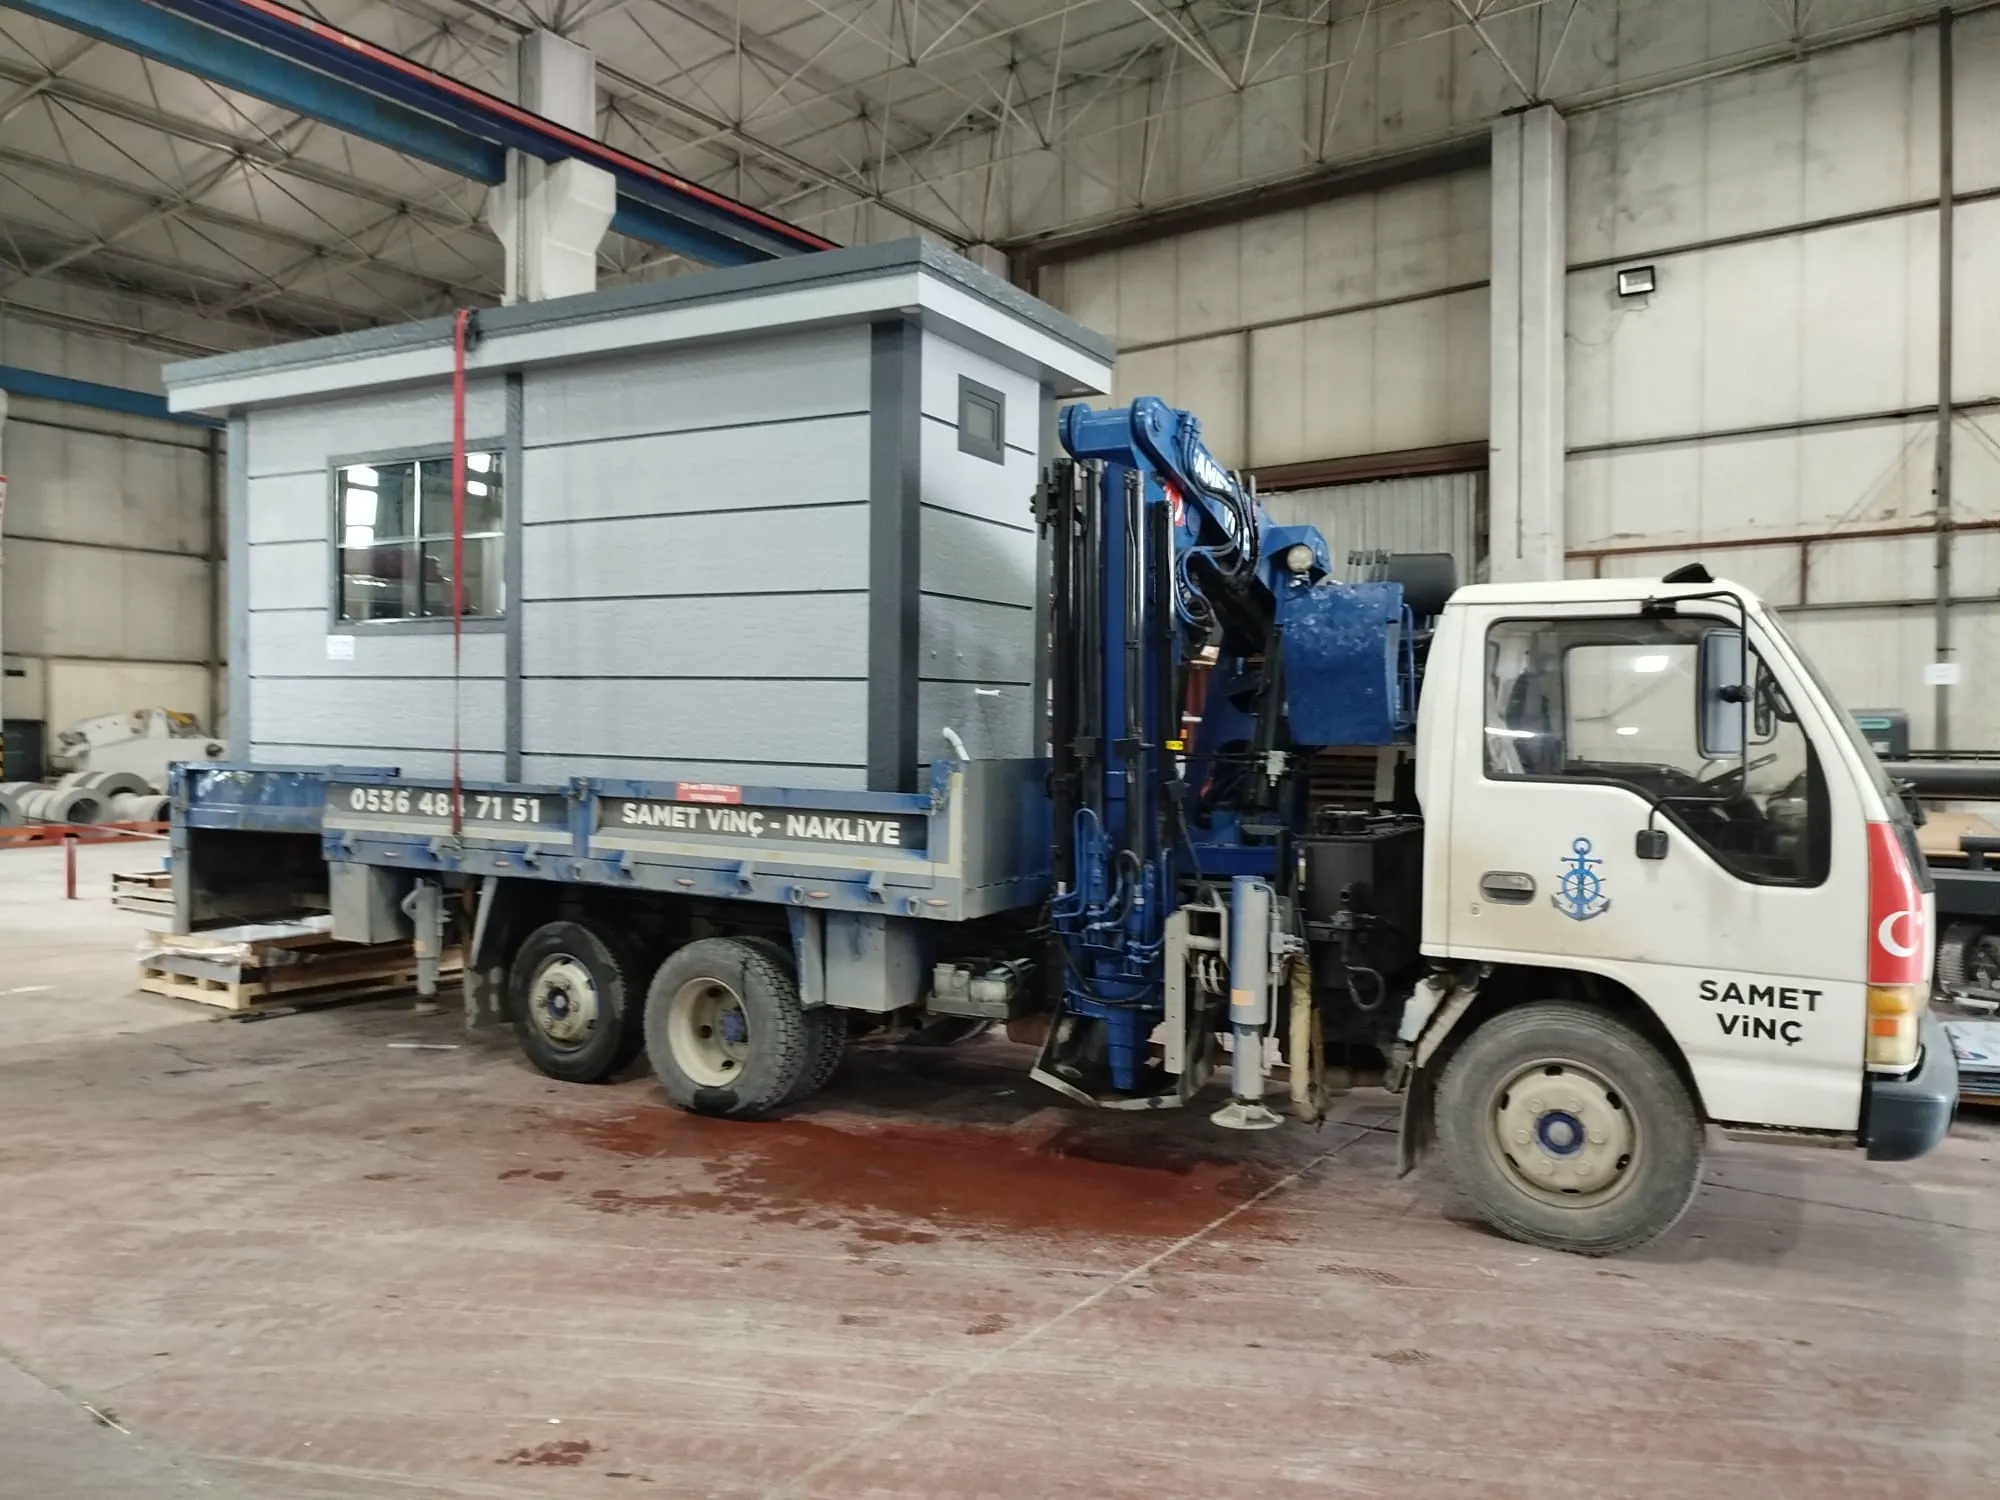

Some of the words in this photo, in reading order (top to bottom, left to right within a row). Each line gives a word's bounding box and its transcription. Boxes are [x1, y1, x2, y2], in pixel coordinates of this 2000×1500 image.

[350, 788, 411, 813] 0536
[475, 795, 502, 820] 71
[512, 798, 541, 823] 51
[622, 803, 700, 829] SAMET
[1698, 979, 1824, 1012] SAMET
